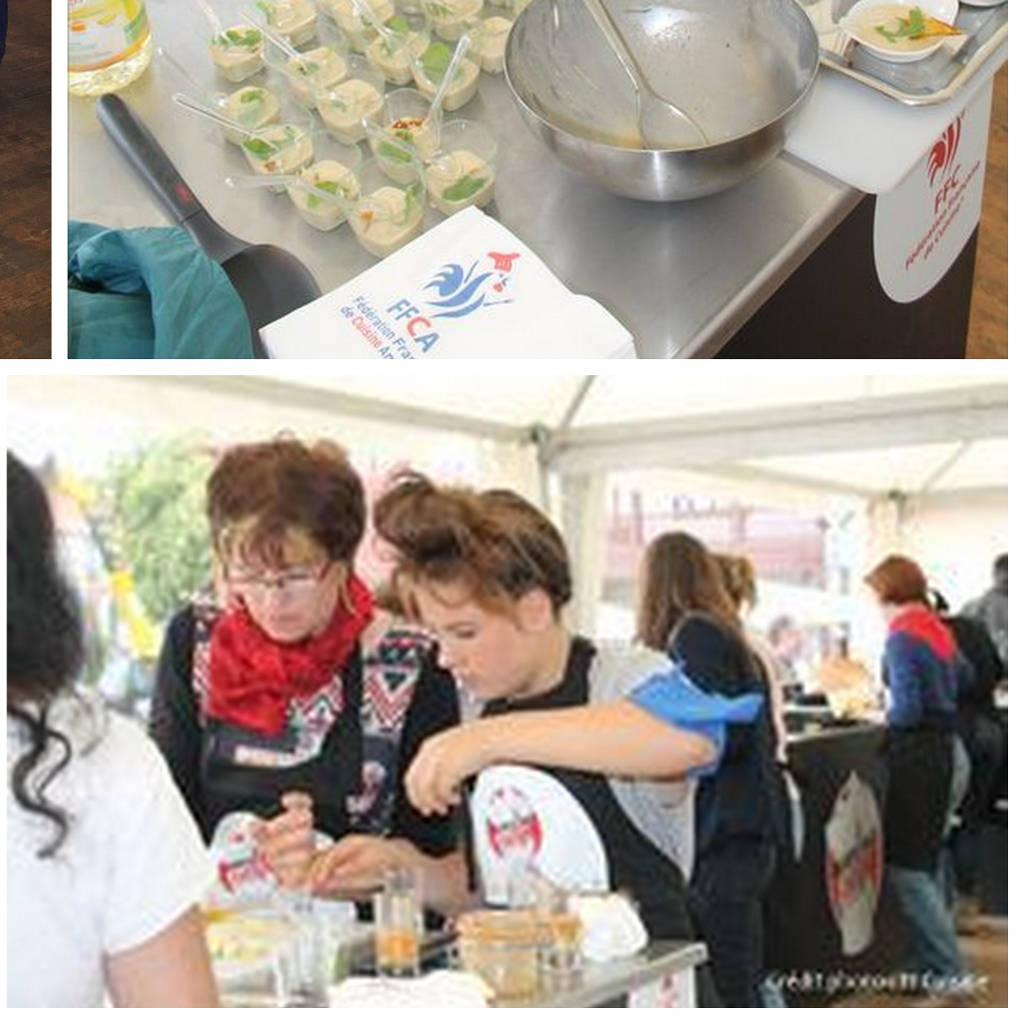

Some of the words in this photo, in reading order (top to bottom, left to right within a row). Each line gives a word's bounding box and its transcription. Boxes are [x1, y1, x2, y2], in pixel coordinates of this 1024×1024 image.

[340, 306, 354, 319] de
[352, 316, 382, 348] Cuisine
[353, 296, 396, 340] Fédération
[387, 299, 440, 353] FFCA
